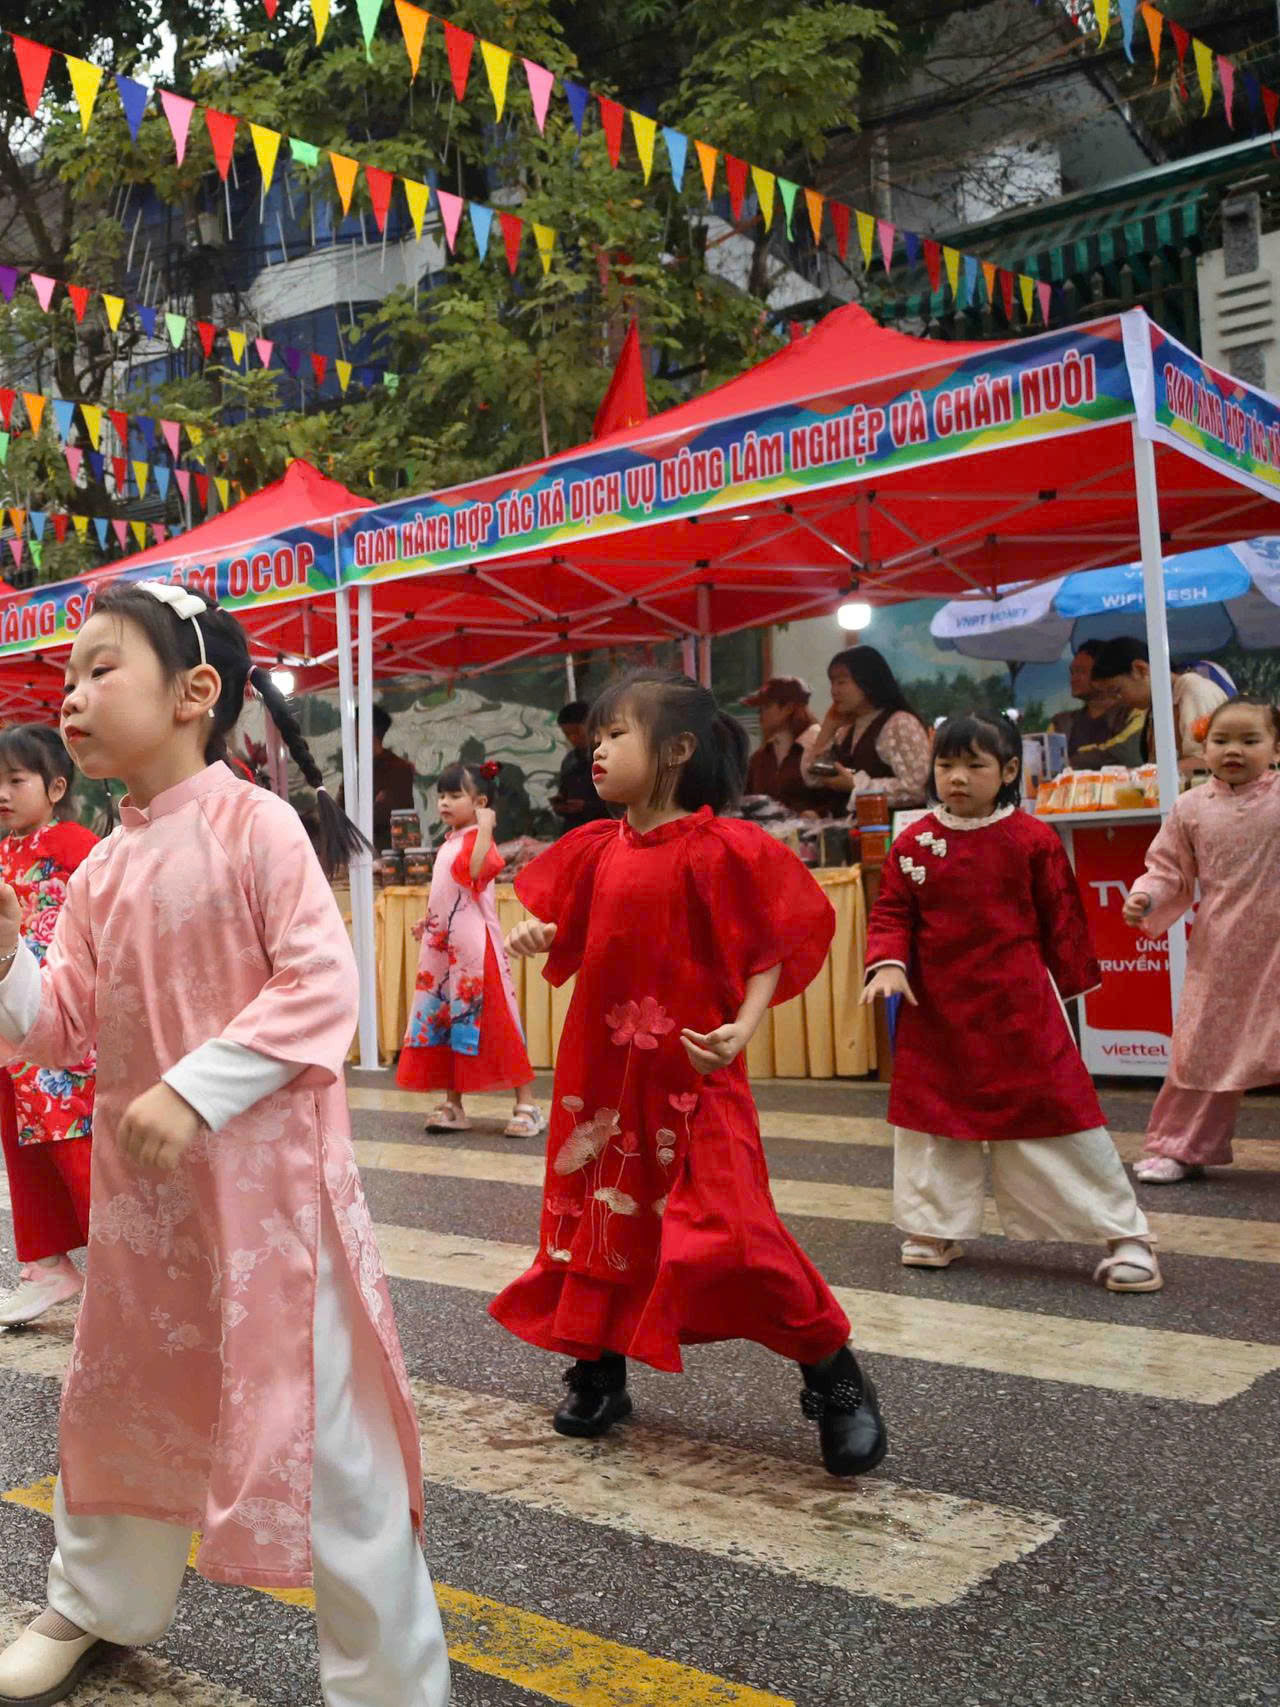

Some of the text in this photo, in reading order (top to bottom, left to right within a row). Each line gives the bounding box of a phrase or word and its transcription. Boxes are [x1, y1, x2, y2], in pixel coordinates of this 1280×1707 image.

[354, 349, 1096, 567] GIAN HÀNG HỢP TÁC XÃ DỊCH VỤ NÔNG LÂM NGHIỆP VÀ CHĂN NUÔI
[228, 542, 315, 599] OCOP
[1167, 586, 1209, 600] ESH
[1102, 1042, 1169, 1056] viettel
